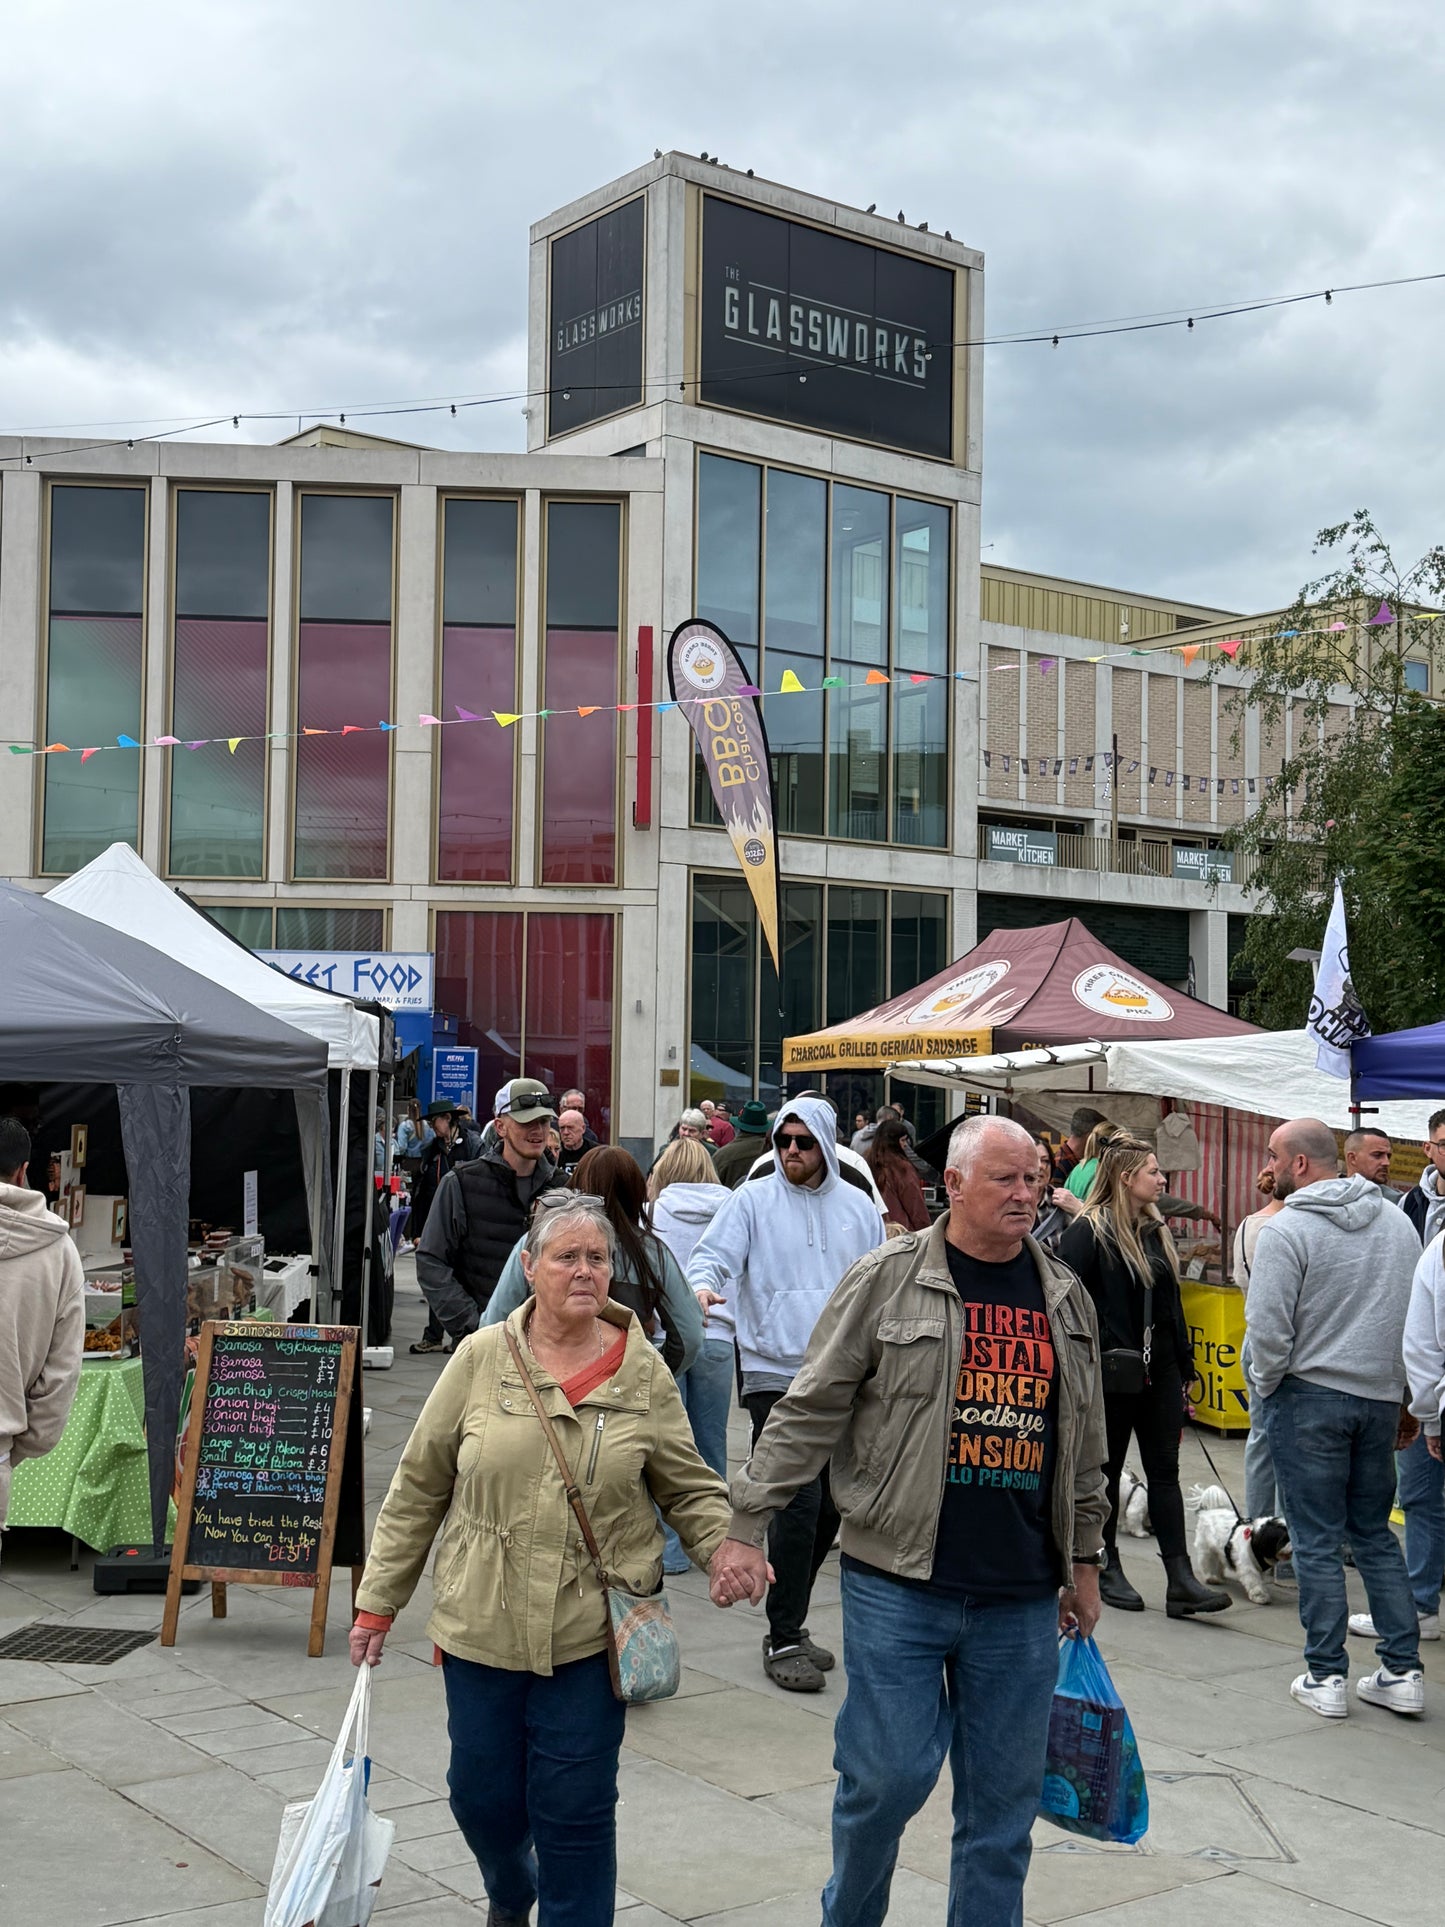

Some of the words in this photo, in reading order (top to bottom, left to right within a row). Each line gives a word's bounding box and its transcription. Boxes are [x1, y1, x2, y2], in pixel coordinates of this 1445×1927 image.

[725, 266, 741, 281] THE
[557, 295, 641, 351] GLASSWORKS
[724, 286, 928, 379] GLASSWORKS
[992, 831, 1028, 847] MARKET
[1018, 848, 1054, 865] KITCHEN
[1177, 851, 1208, 866] MARKET
[1200, 867, 1231, 882] KIEN
[353, 958, 423, 994] FOOD
[1084, 971, 1106, 993] THREE
[403, 997, 423, 1005] FRIES
[791, 1043, 836, 1062] CHARCOAL
[839, 1041, 877, 1057] GRILLED
[880, 1038, 923, 1056] GERMAN
[926, 1037, 978, 1055] SAUSAGE
[223, 1322, 283, 1337] Samosa
[964, 1302, 1050, 1341] TIRED
[215, 1338, 265, 1352] Samosa
[207, 1381, 241, 1397] Onion
[243, 1382, 273, 1399] Bhaji
[254, 1398, 281, 1414] bhaji
[201, 1434, 233, 1452] Large
[199, 1448, 227, 1464] Small
[233, 1451, 252, 1469] Bag
[213, 1468, 255, 1481] Samosa
[271, 1472, 302, 1481] Onion
[946, 1466, 972, 1484] LO
[978, 1468, 1041, 1491] PENSION
[242, 1480, 252, 1493] of
[194, 1506, 212, 1525] You
[218, 1508, 242, 1526] have
[248, 1512, 275, 1527] tried
[281, 1515, 299, 1528] the
[302, 1515, 323, 1530] Rest
[204, 1526, 227, 1539] Now
[231, 1528, 249, 1543] You
[253, 1532, 272, 1543] Can
[278, 1532, 294, 1550] try
[298, 1531, 316, 1546] the
